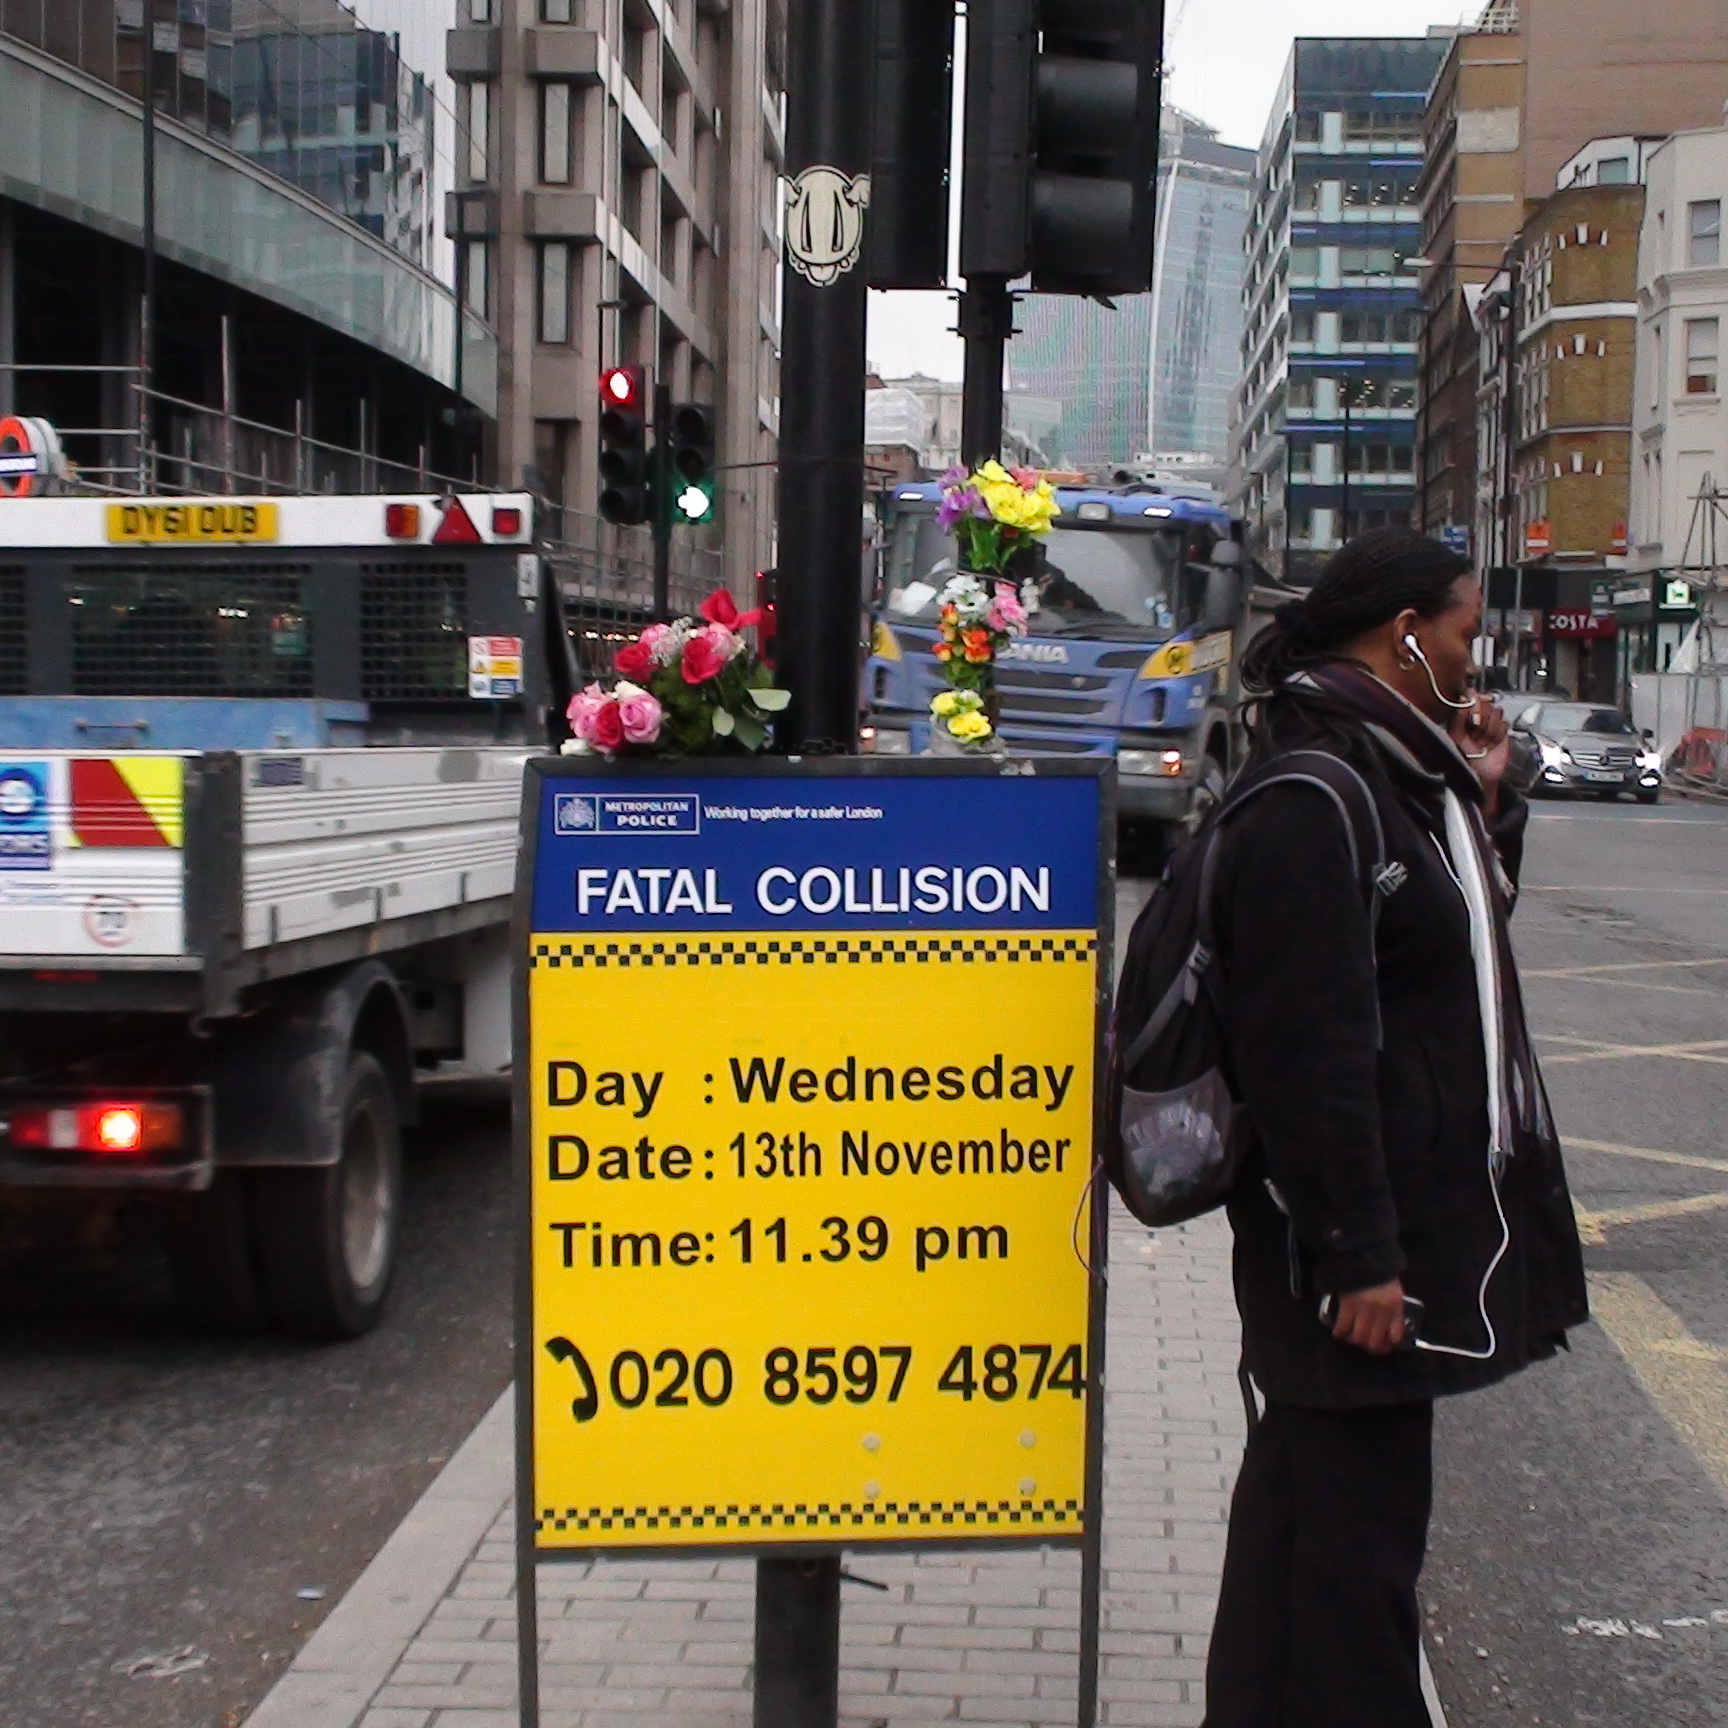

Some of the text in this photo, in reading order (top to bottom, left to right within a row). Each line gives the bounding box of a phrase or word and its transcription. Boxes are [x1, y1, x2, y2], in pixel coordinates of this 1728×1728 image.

[605, 801, 689, 813] METROPOLITAN
[616, 814, 678, 827] POLICE
[703, 805, 883, 822] Working together for a safer London
[577, 866, 1050, 915] FATAL COLLISION
[547, 1060, 665, 1119] Day
[728, 1053, 1075, 1112] Wednesday
[548, 1127, 1072, 1181] Date: 13th November
[549, 1215, 1008, 1273] Time: 11.39 pm
[609, 1343, 1087, 1408] 020 8597 4874
